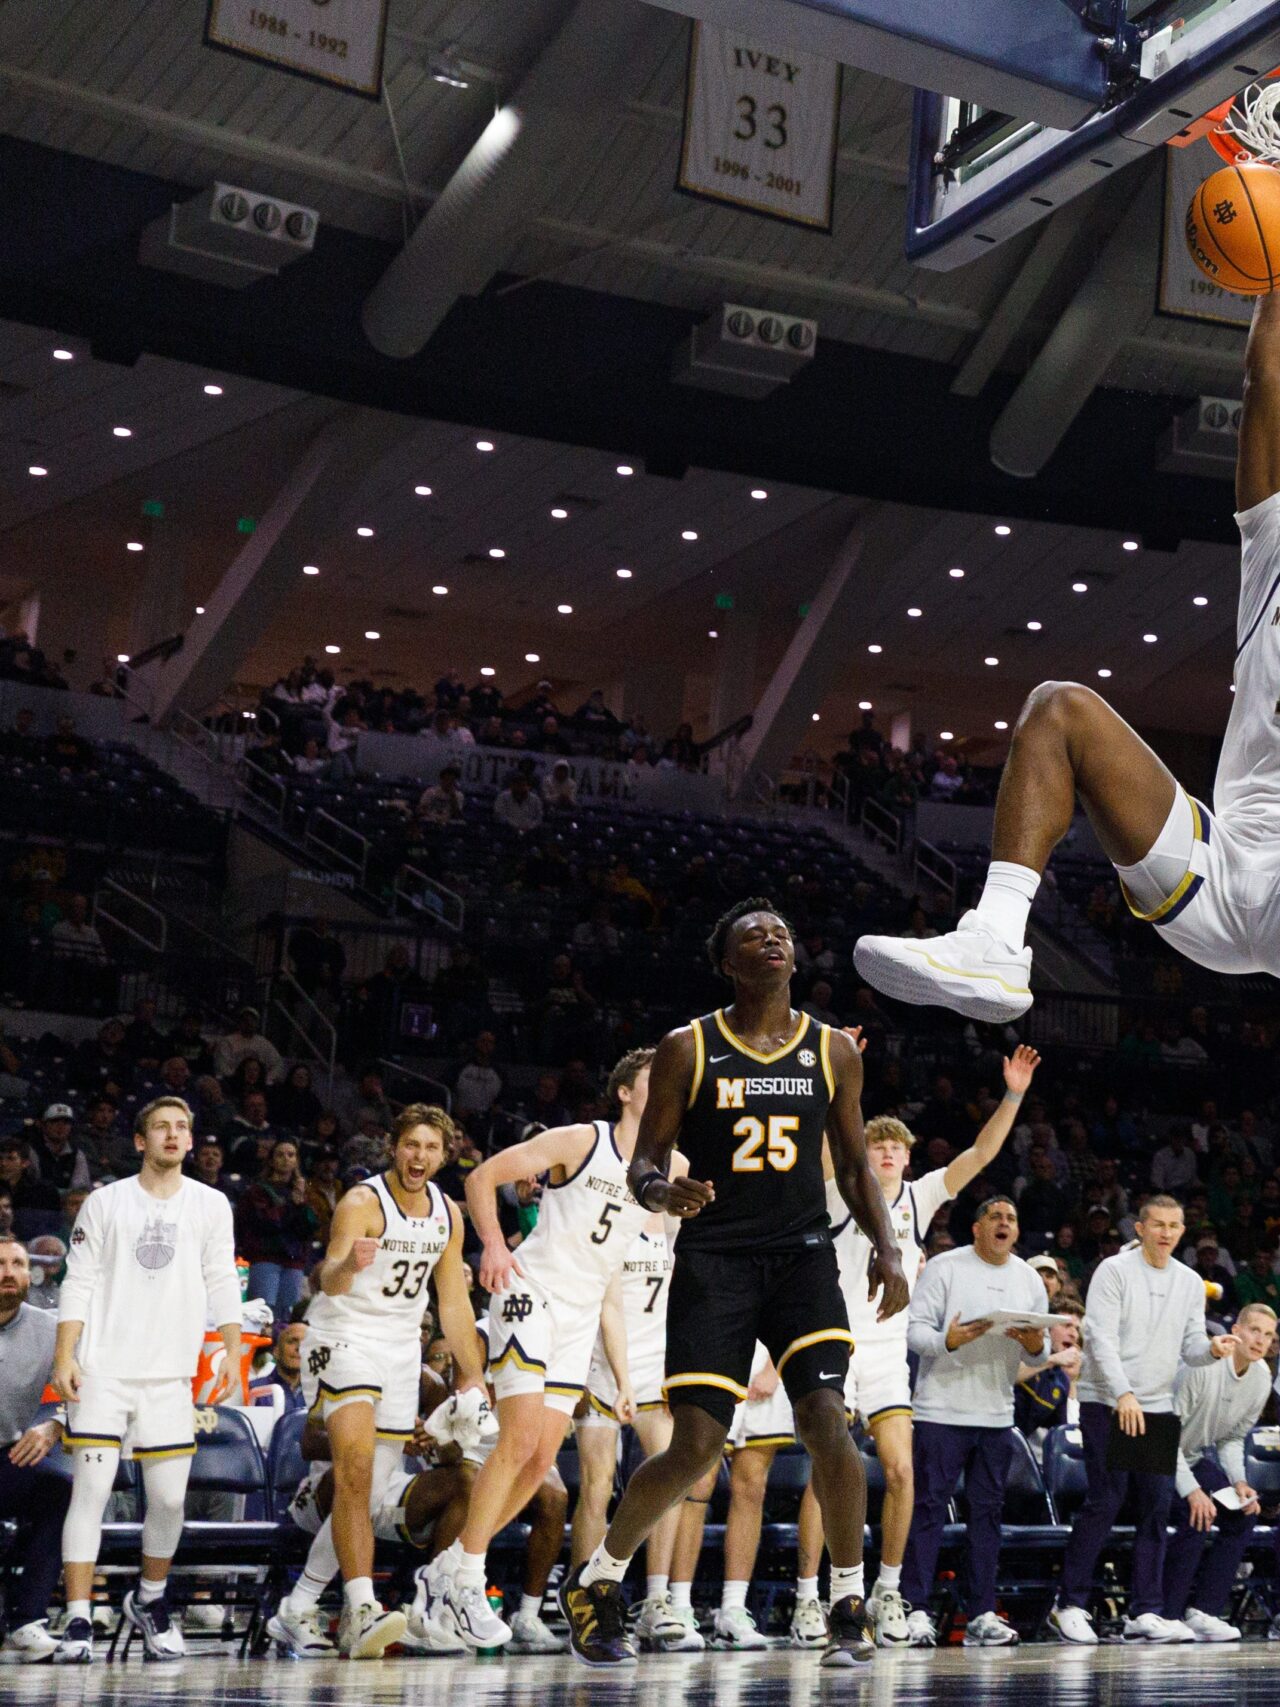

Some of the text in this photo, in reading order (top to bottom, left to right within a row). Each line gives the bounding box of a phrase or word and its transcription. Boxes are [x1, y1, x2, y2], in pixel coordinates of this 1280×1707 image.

[733, 47, 800, 84] IVEY
[733, 95, 788, 149] 33
[766, 171, 802, 195] 2001
[716, 1077, 814, 1109] MISSOURI
[732, 1115, 800, 1172] 25
[584, 1175, 623, 1199] NOTRE
[590, 1202, 623, 1245] 5
[381, 1239, 446, 1255] NOTRE DAME
[382, 1260, 429, 1299] 33
[622, 1260, 658, 1272] NOTRE
[643, 1277, 664, 1313] 7
